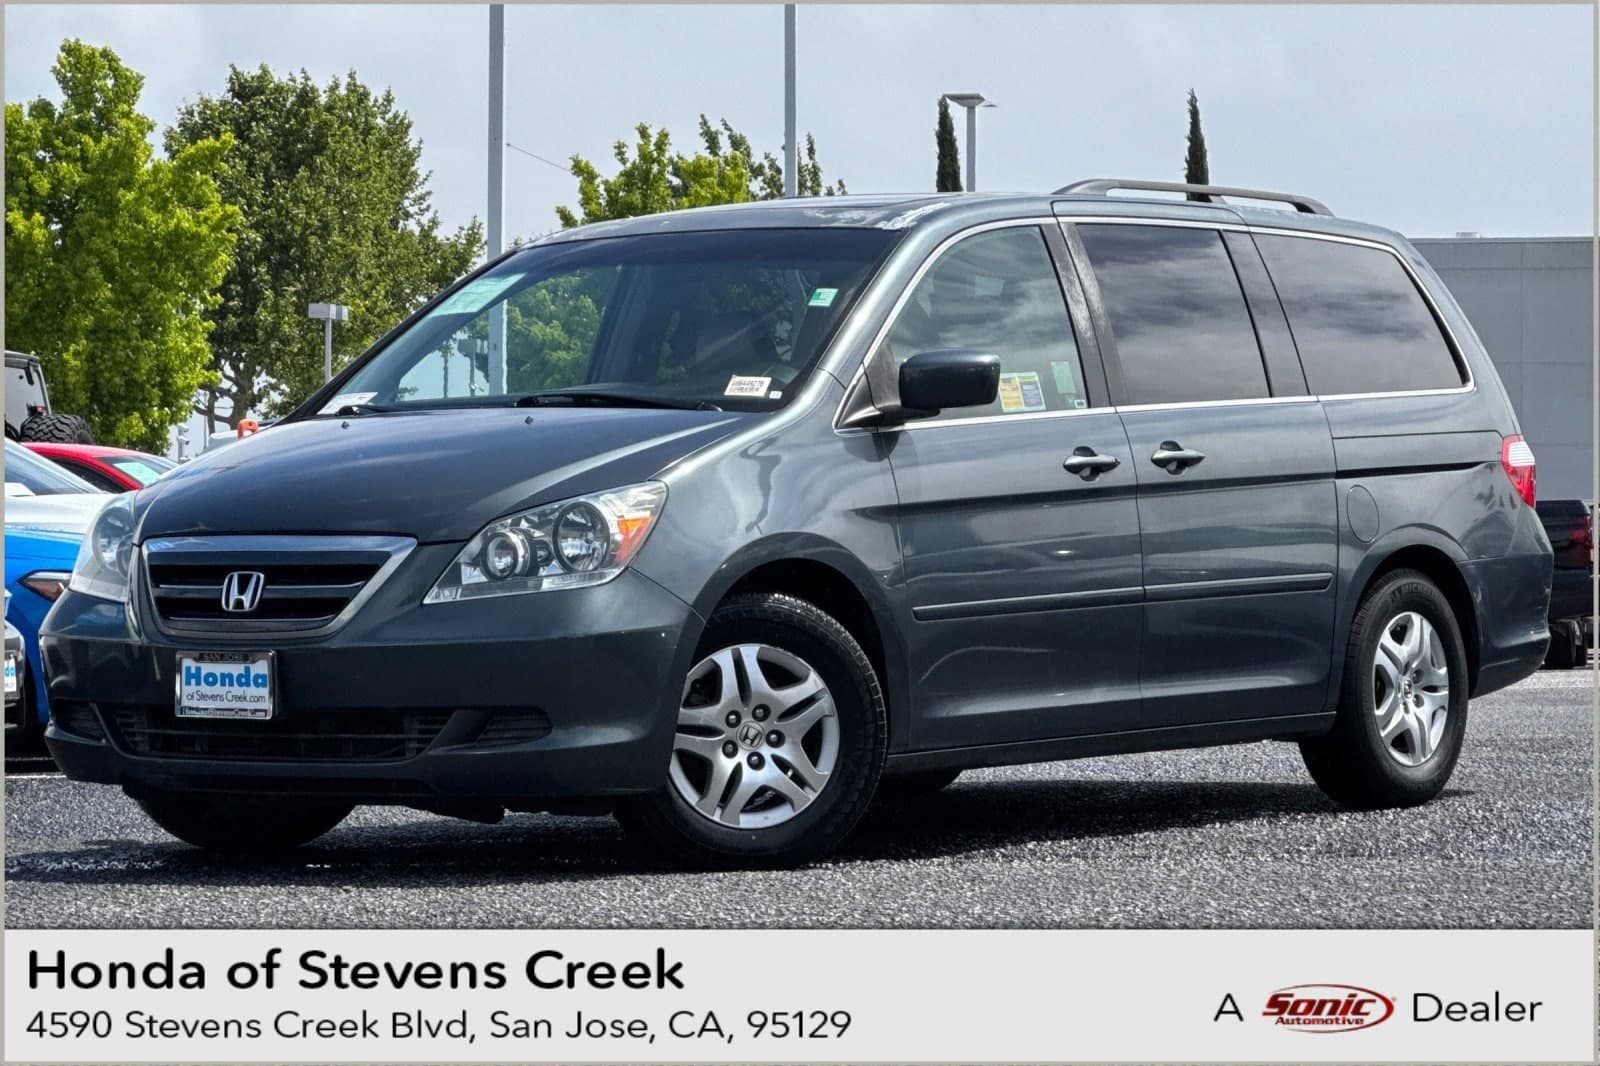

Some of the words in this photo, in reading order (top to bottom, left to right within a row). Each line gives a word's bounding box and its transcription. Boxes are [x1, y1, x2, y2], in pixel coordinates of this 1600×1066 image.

[185, 665, 268, 688] Honda
[186, 691, 195, 701] of
[196, 690, 224, 702] Stevens
[225, 690, 266, 703] Creek.com
